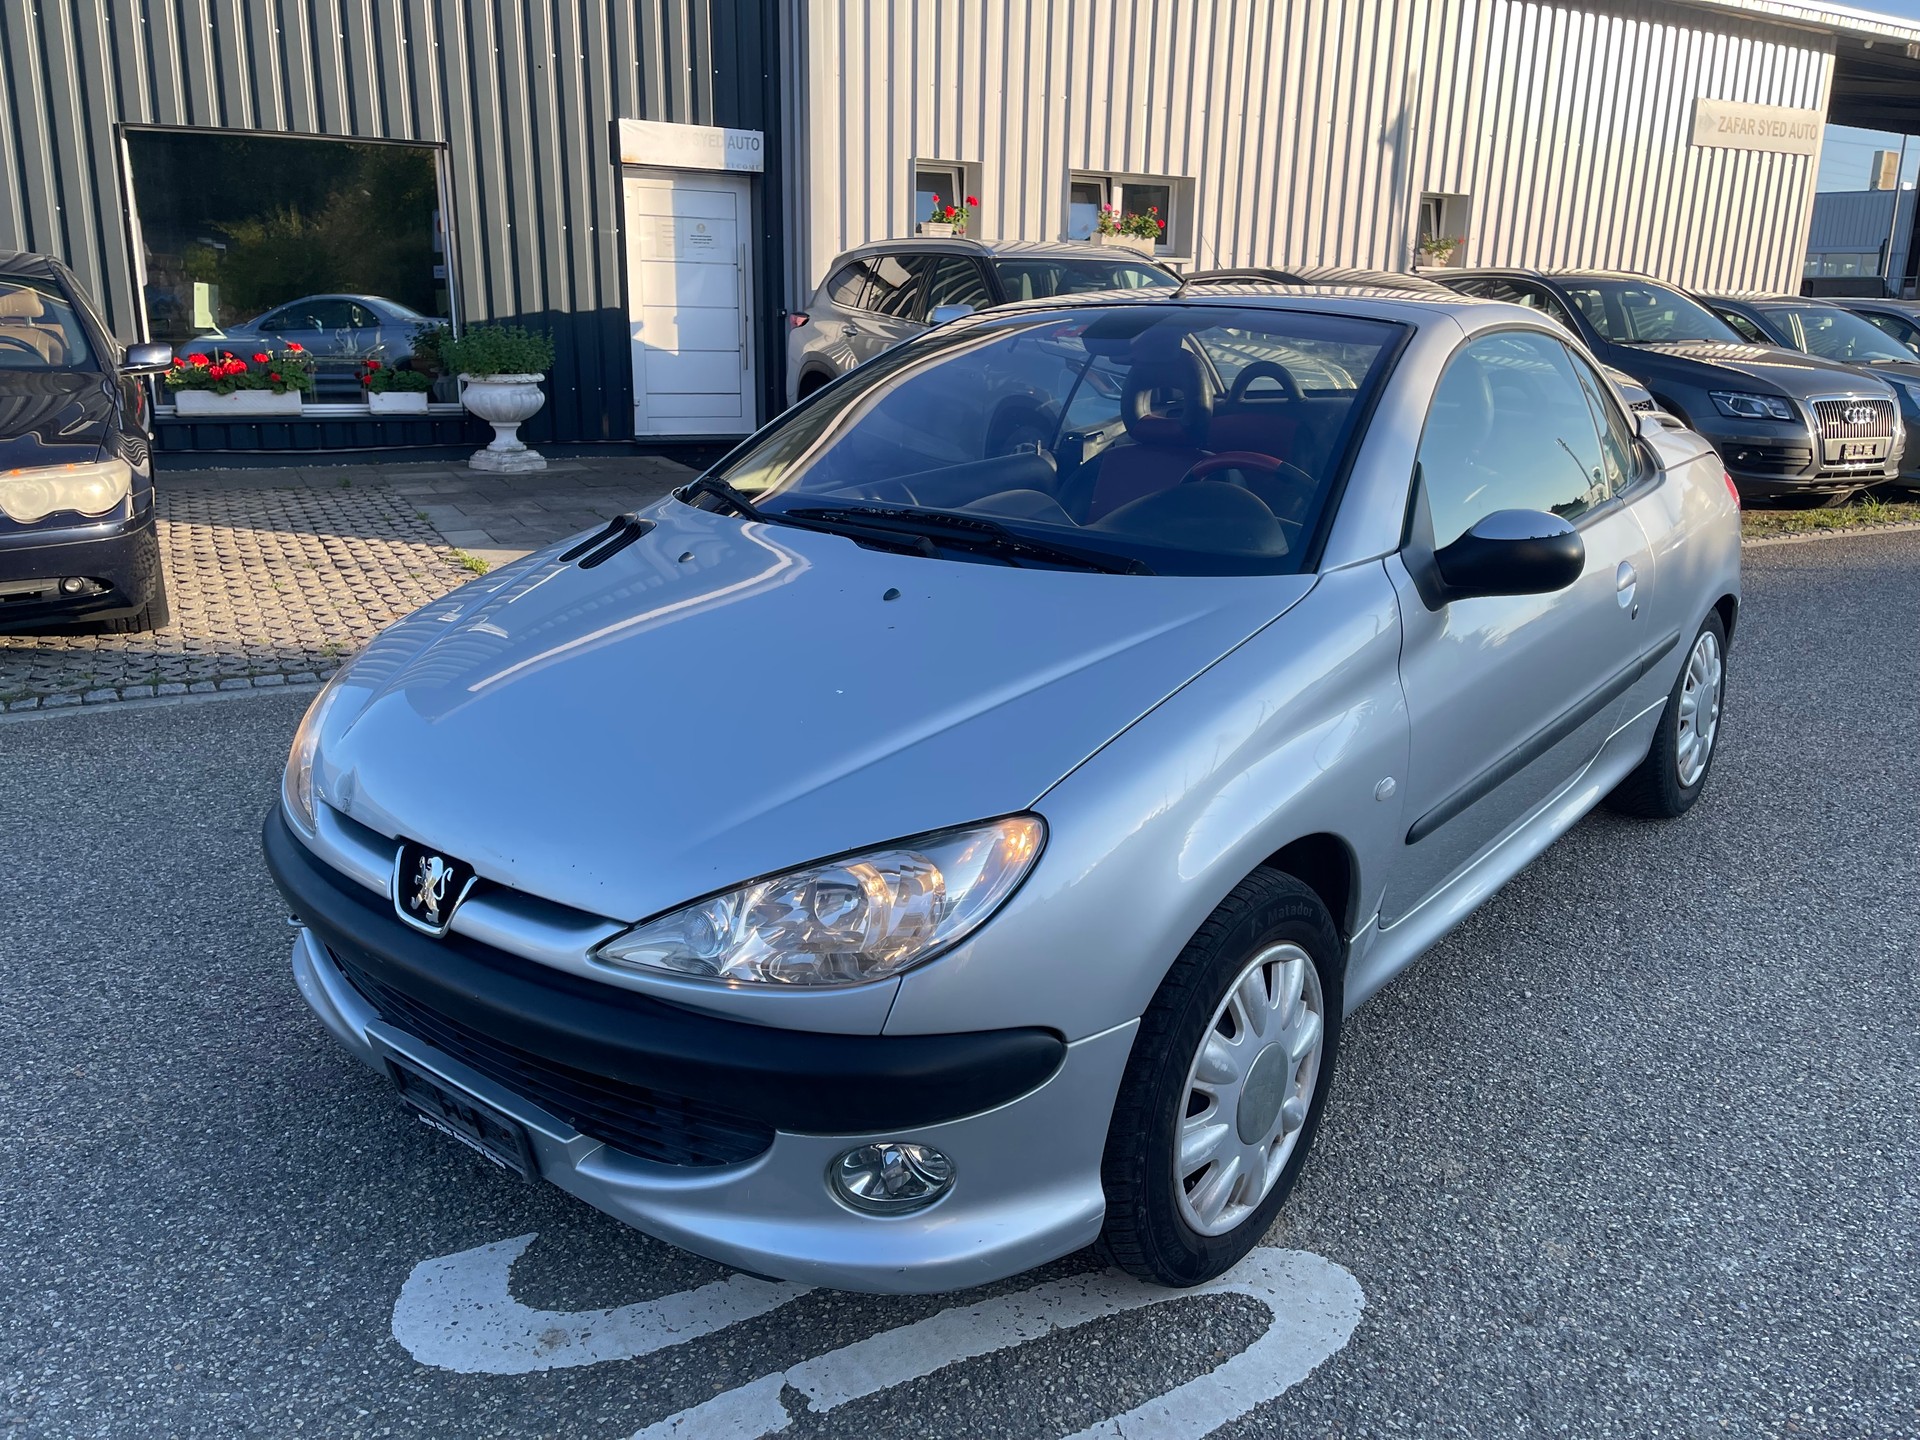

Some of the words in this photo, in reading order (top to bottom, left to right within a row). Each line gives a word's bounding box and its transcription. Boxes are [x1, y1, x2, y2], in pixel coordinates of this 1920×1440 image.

[1717, 115, 1756, 135] ZAFAR
[1758, 118, 1787, 137] SYED
[1789, 122, 1817, 140] AUTO
[727, 135, 760, 151] AUTO
[1267, 902, 1313, 925] Matador
